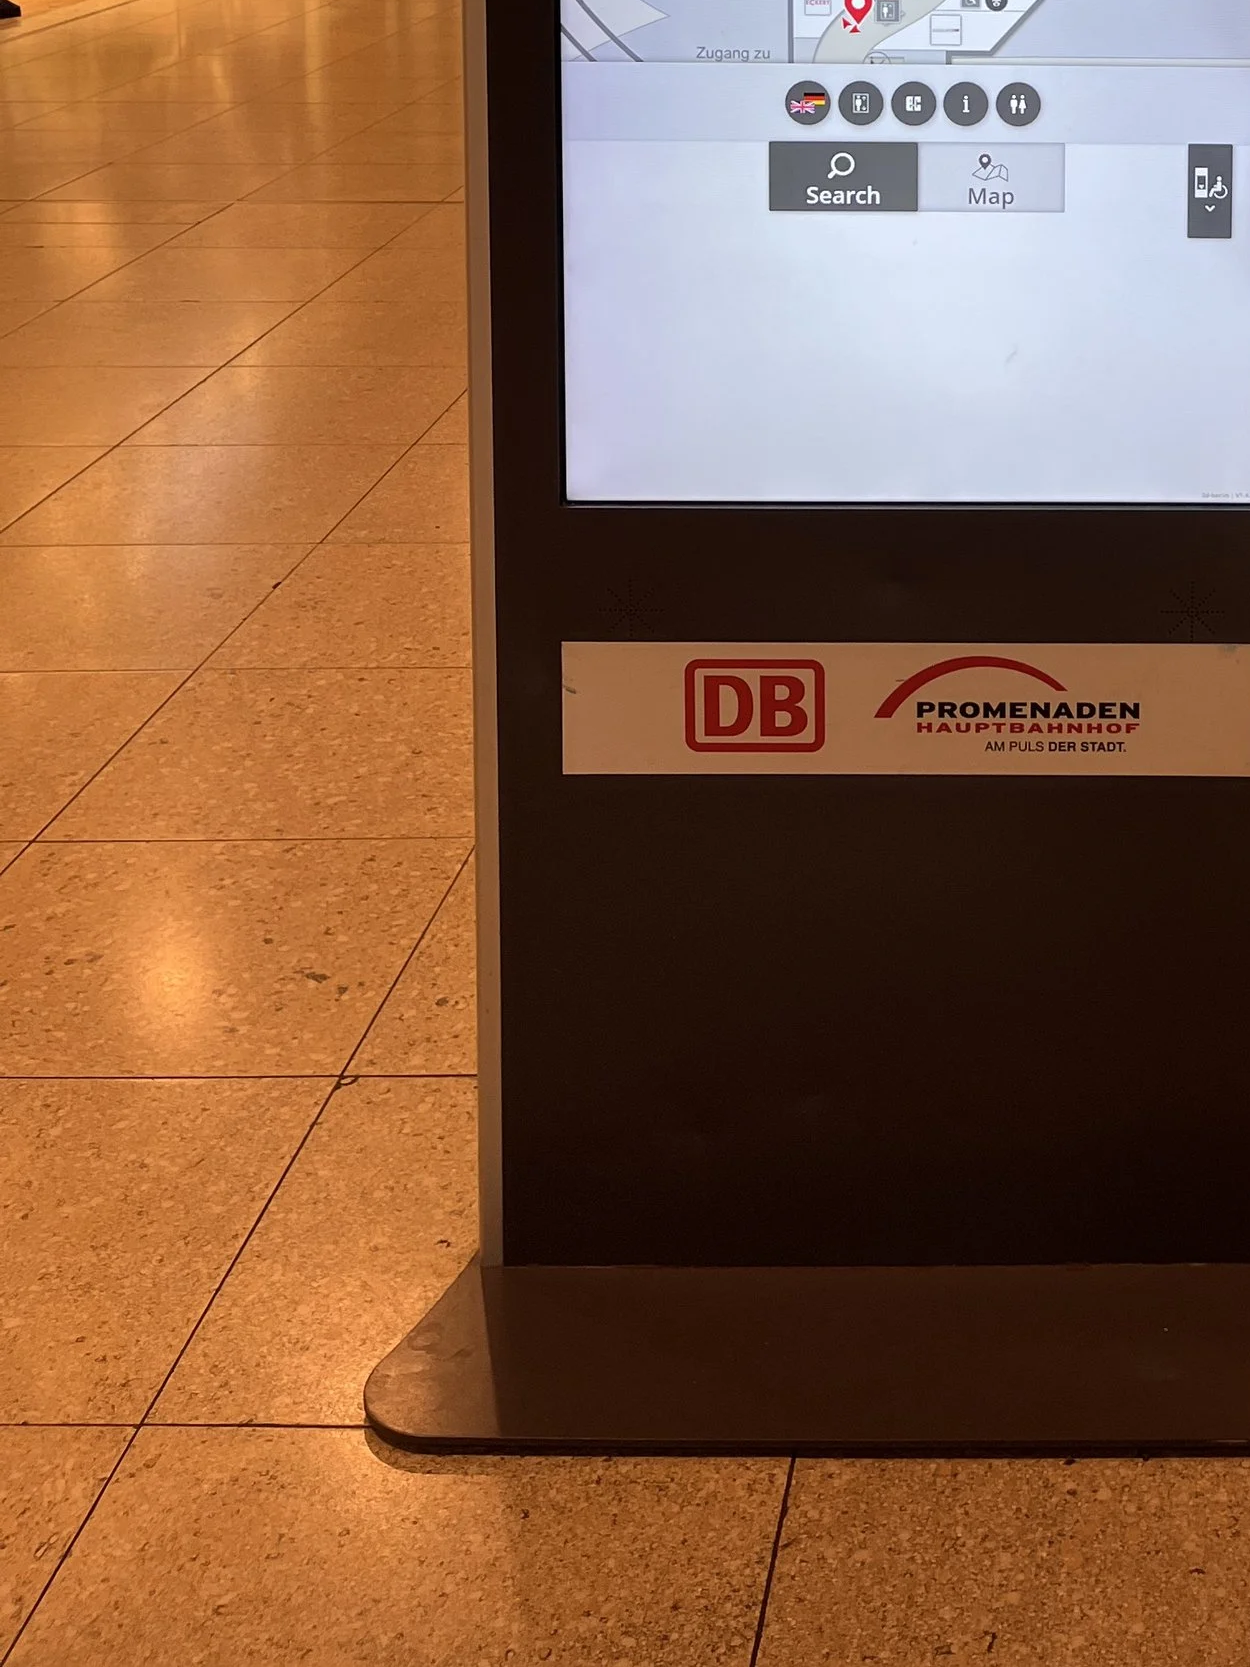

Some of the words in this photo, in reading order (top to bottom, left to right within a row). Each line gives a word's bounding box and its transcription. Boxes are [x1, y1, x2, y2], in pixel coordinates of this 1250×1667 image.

[695, 46, 750, 62] Zugang
[754, 47, 771, 60] zu
[806, 185, 881, 206] Search
[967, 187, 1015, 210] Map
[703, 674, 809, 738] DB
[916, 701, 1140, 720] PROMENADEN
[916, 721, 1141, 735] HAUPTBAHNHOF
[984, 741, 1006, 753] AM
[1008, 741, 1045, 753] PULS
[1047, 741, 1077, 753] DER
[1080, 741, 1127, 753] STADT.
